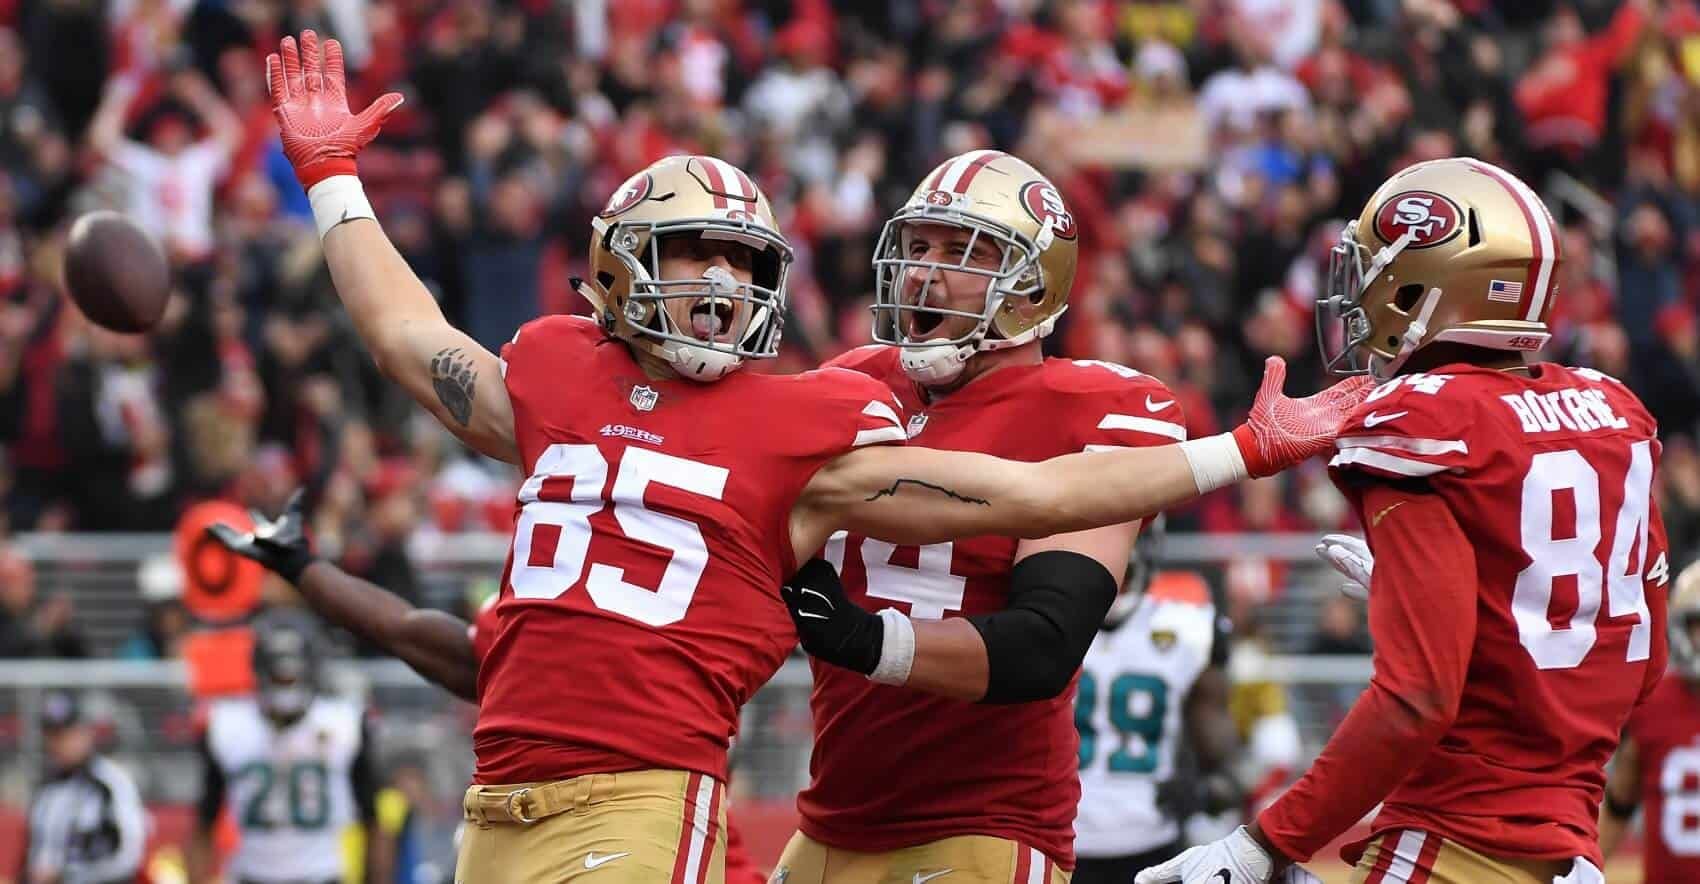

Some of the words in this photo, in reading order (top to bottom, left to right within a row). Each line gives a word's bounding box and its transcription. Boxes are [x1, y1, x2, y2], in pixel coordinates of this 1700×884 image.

[1392, 197, 1446, 241] SF
[599, 424, 664, 446] 49ERS
[510, 443, 730, 627] 85
[1512, 440, 1653, 669] 84
[228, 760, 332, 834] 20
